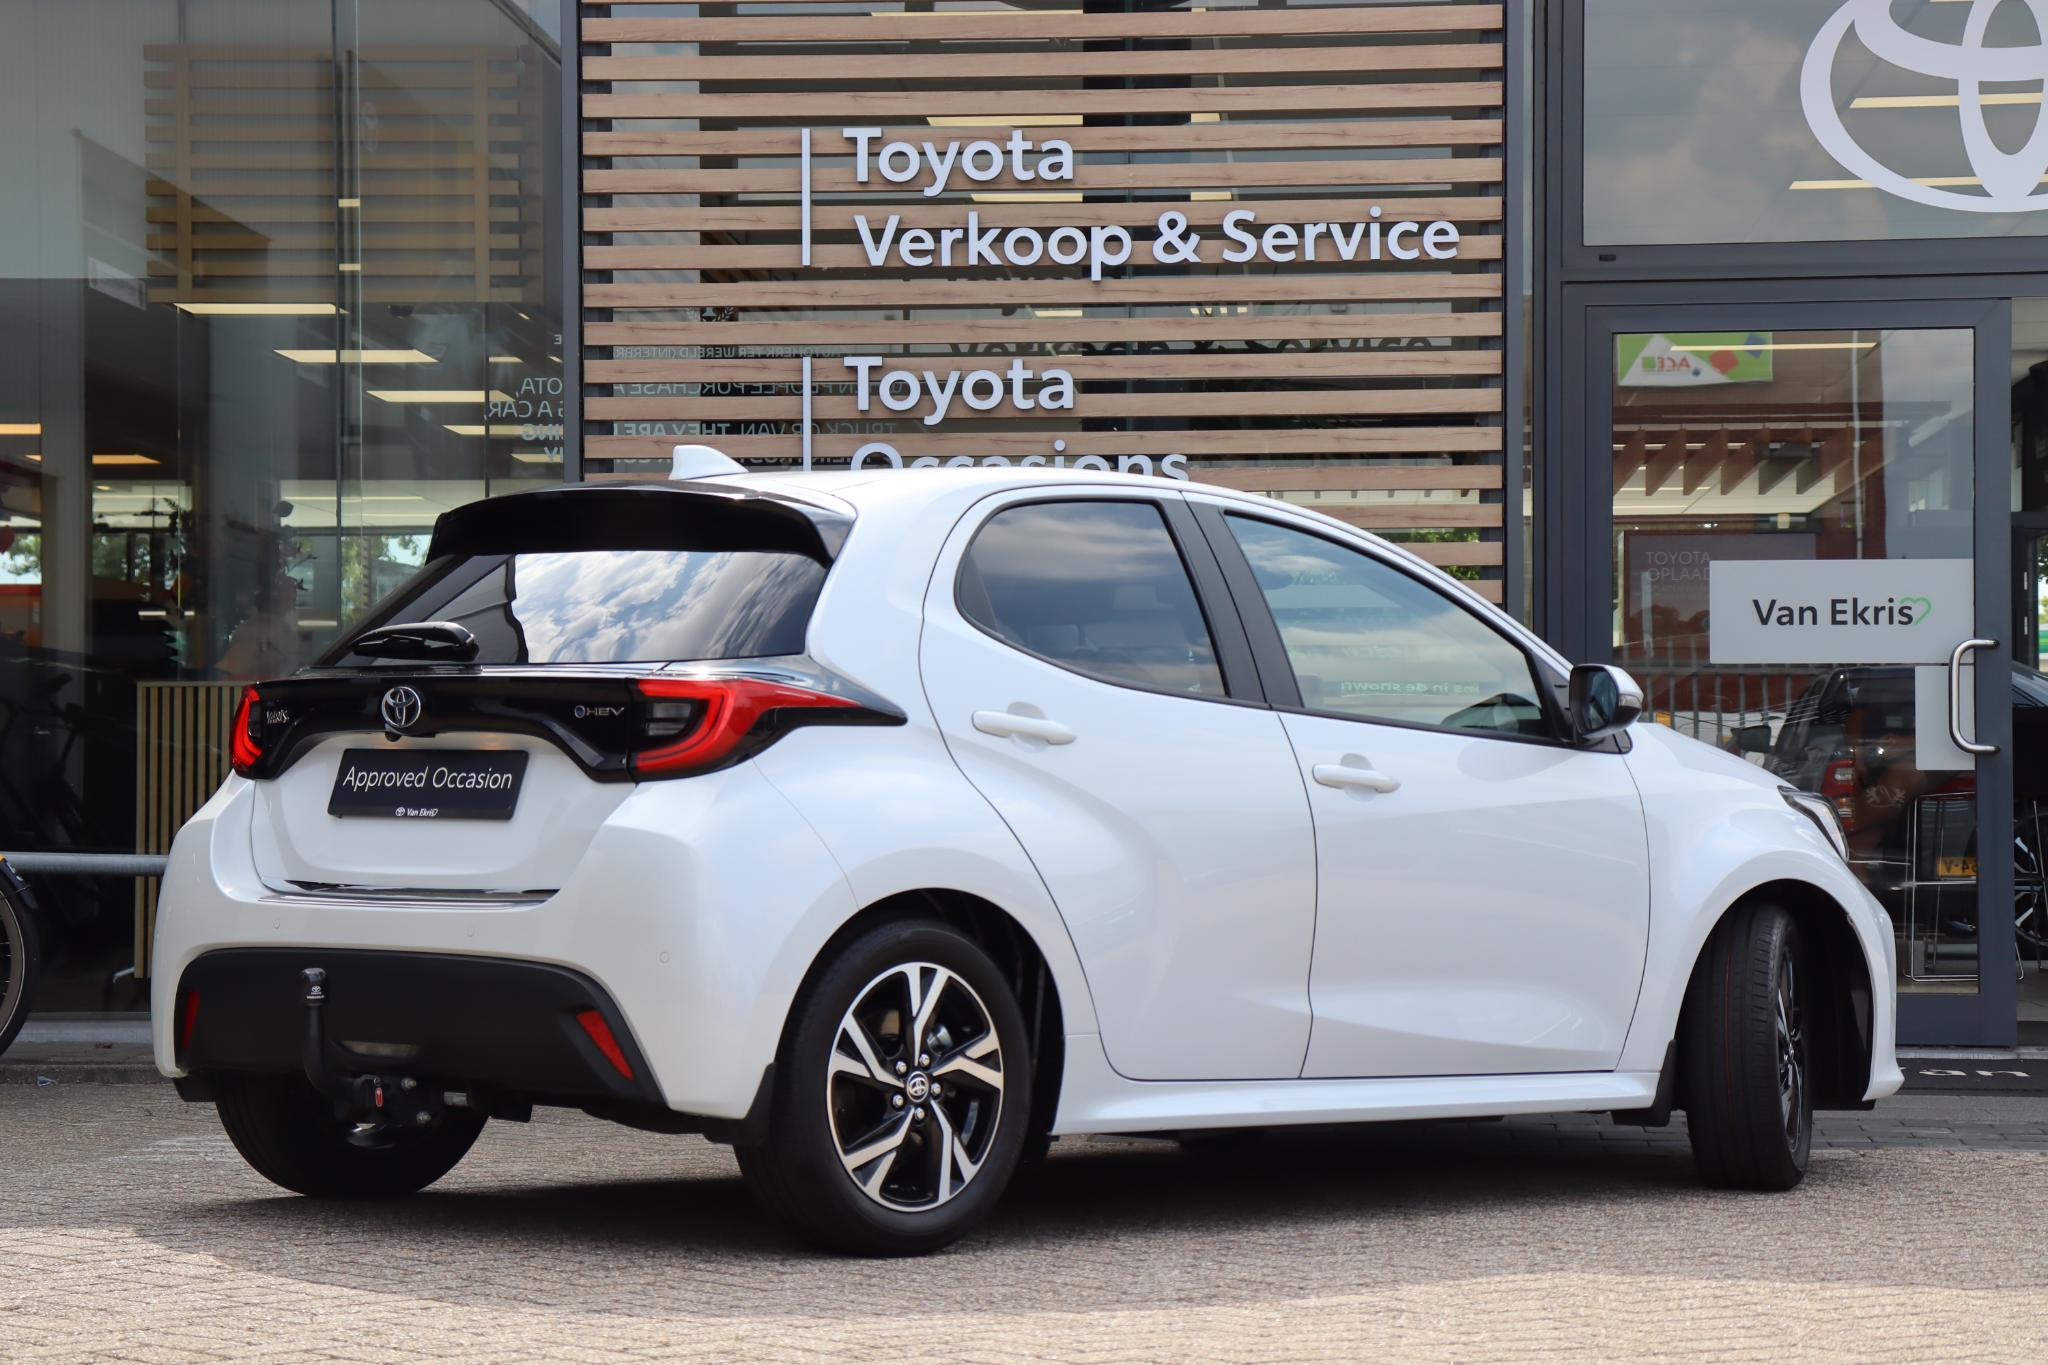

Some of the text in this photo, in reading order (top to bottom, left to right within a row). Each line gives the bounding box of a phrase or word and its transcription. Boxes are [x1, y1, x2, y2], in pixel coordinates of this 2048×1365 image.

[843, 127, 1075, 197] Toyota
[854, 206, 1461, 281] Verkoop & Service
[843, 355, 1075, 425] Toyota
[1646, 551, 1711, 566] TOYOTA
[1752, 597, 1914, 626] Van Ekris
[586, 706, 624, 717] HEV
[343, 764, 513, 793] Approved Occasion
[406, 807, 419, 817] Van
